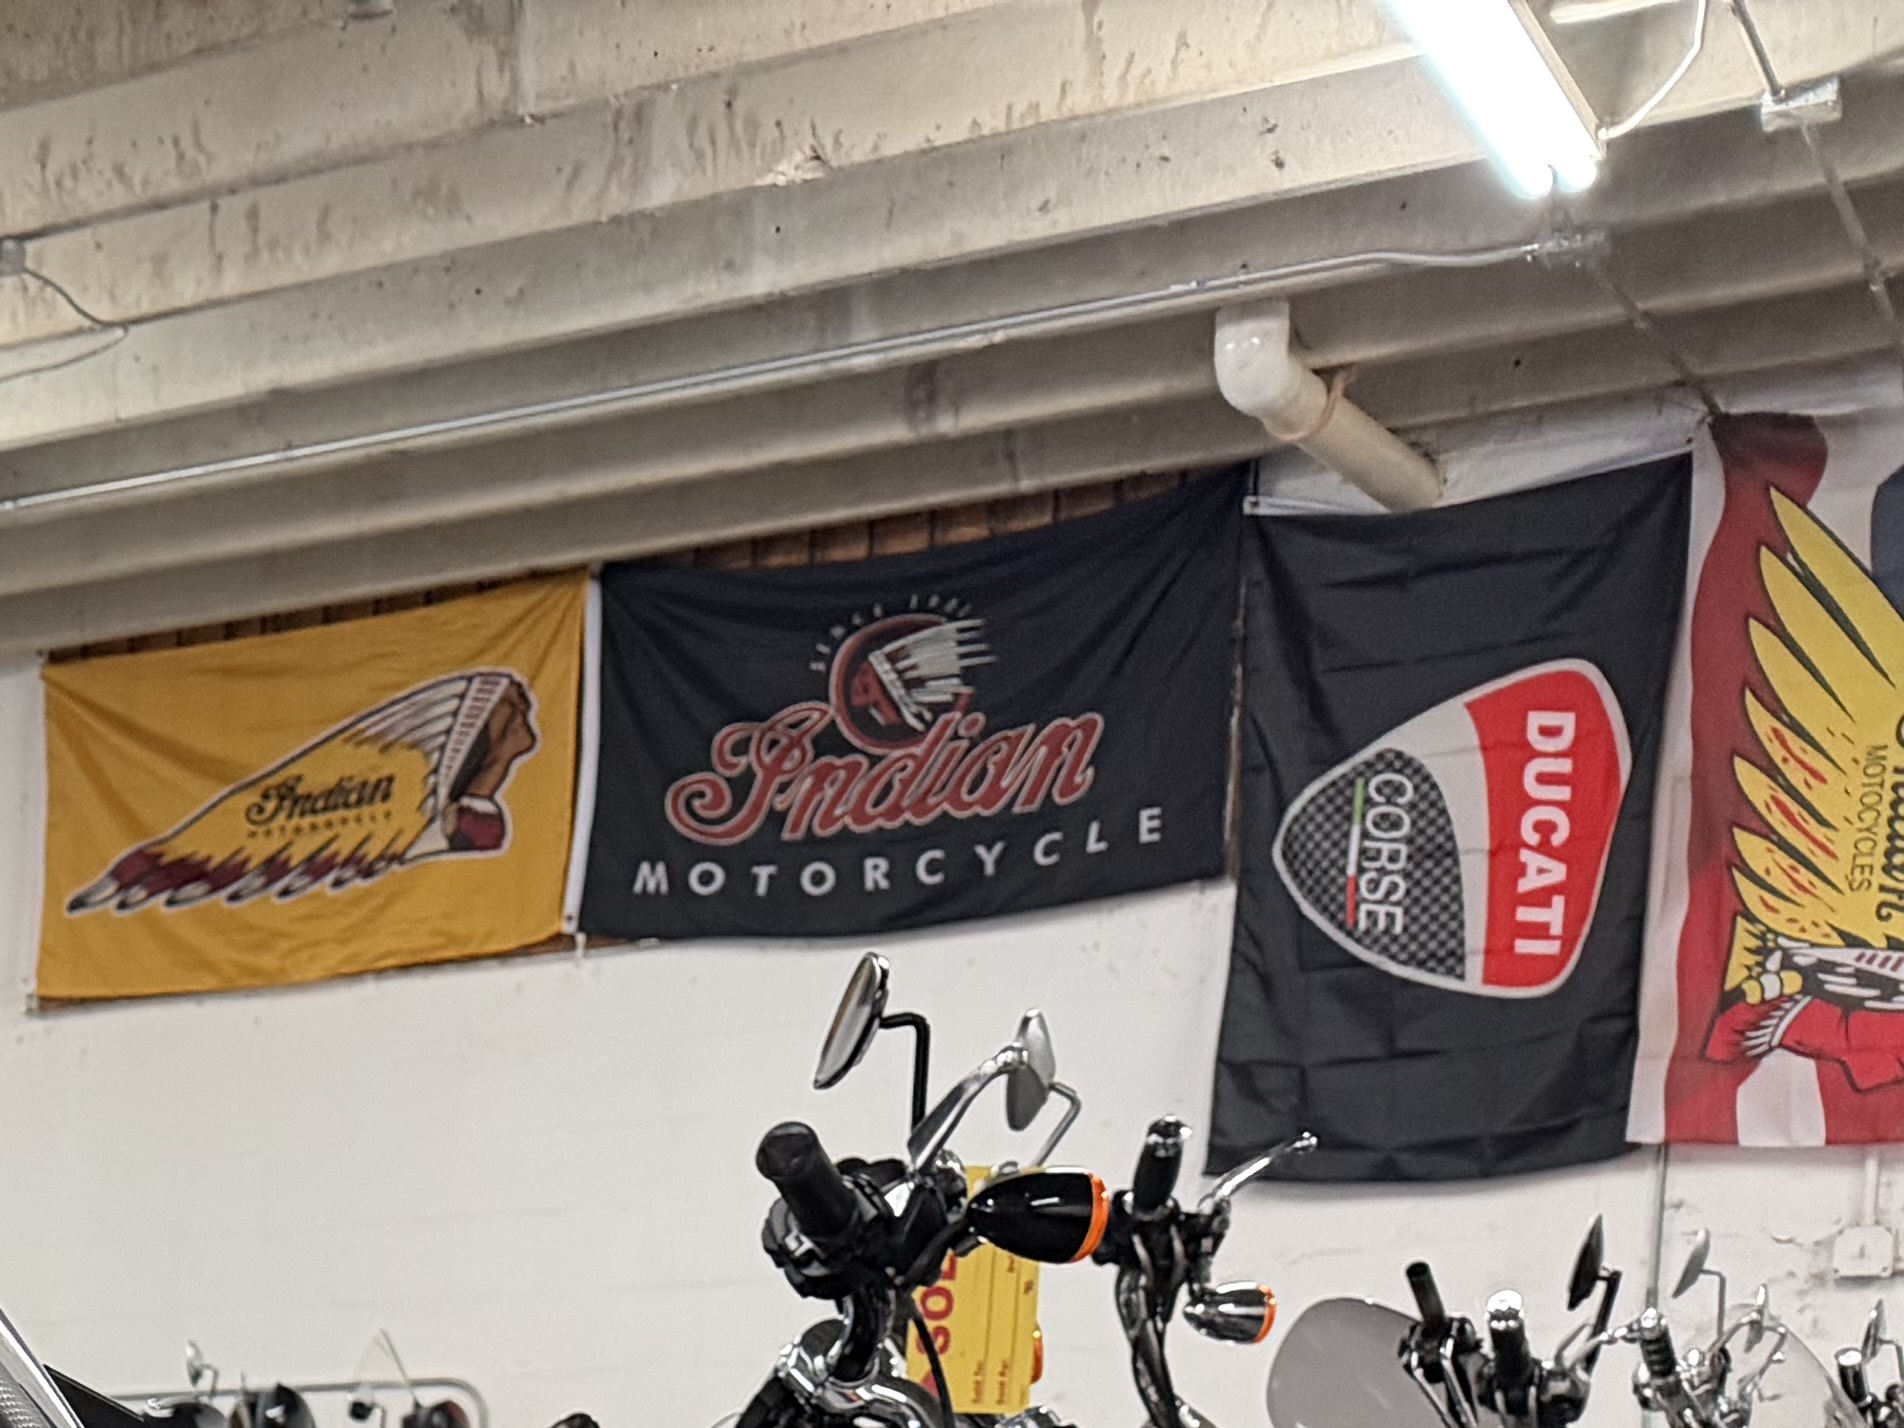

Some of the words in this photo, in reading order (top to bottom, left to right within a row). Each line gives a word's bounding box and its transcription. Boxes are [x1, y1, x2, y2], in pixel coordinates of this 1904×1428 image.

[245, 773, 396, 827] Indian
[665, 700, 1104, 846] Indian
[1514, 710, 1576, 955] DUCATI
[1845, 743, 1889, 893] MOTOCYCLES
[633, 806, 1162, 898] MOTORCYCLE
[1357, 772, 1414, 936] CORSE
